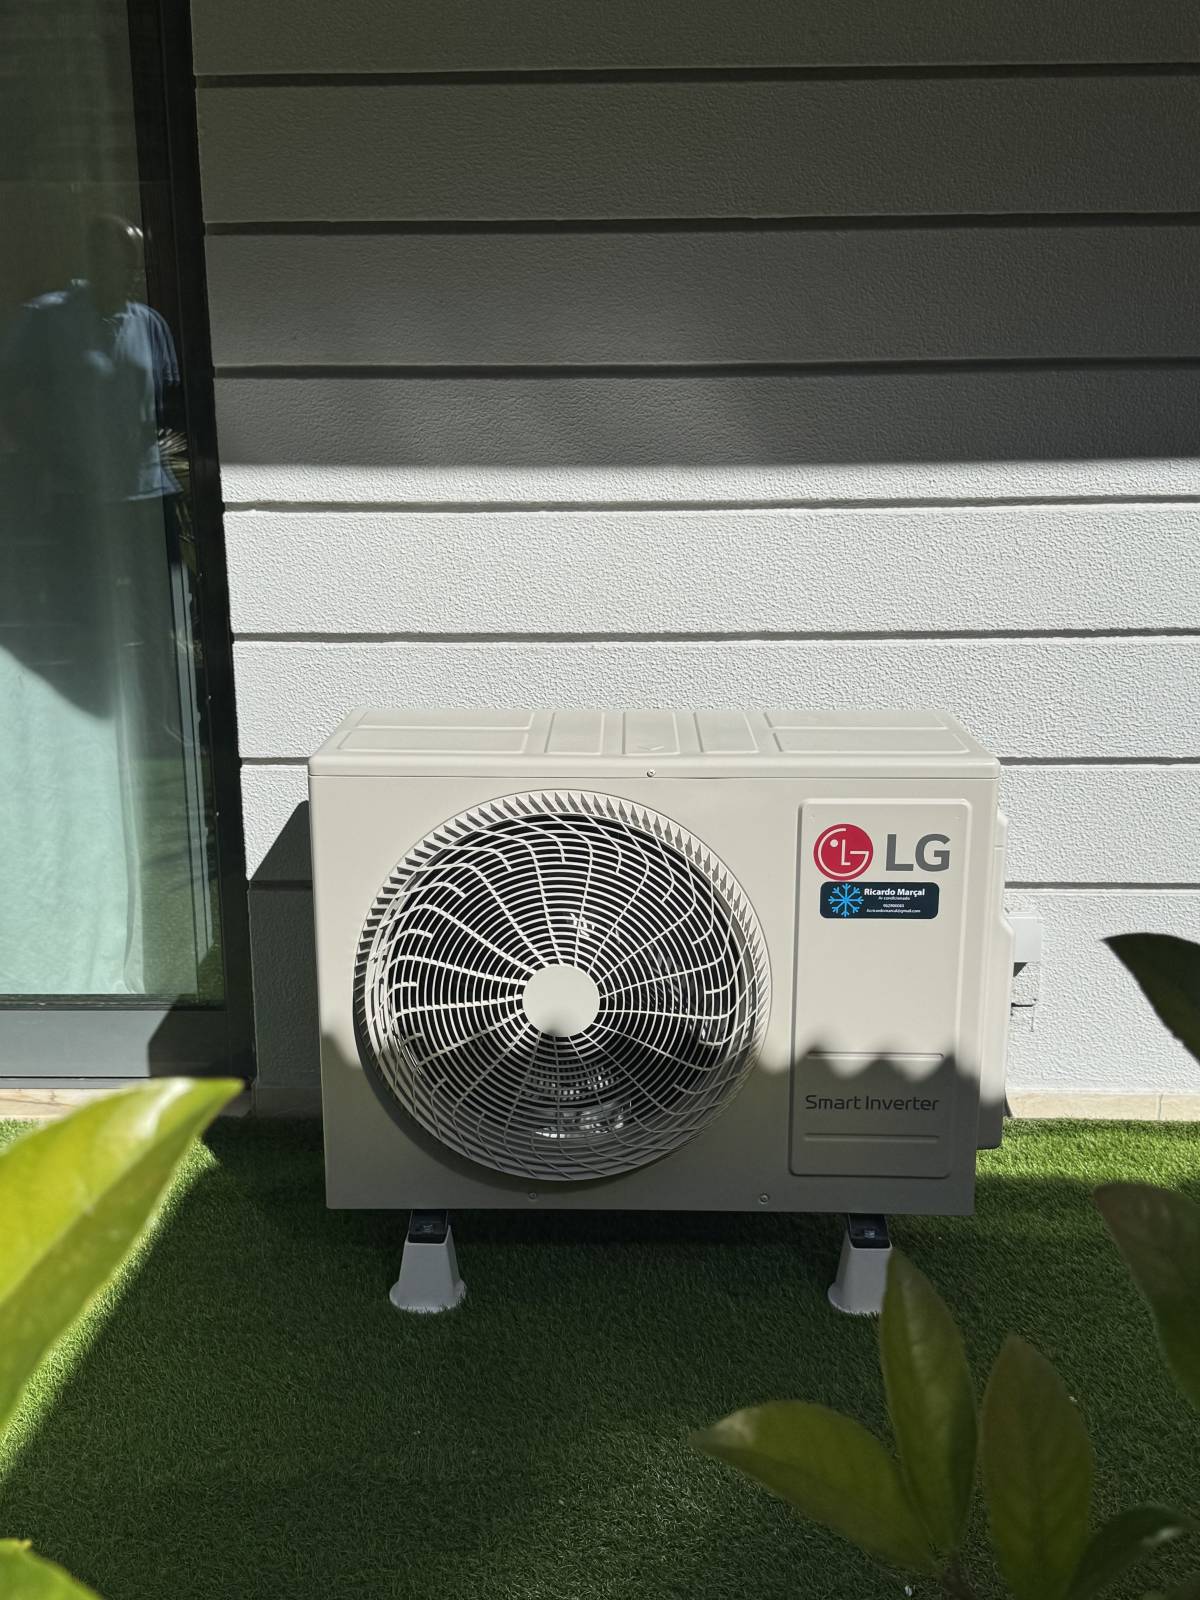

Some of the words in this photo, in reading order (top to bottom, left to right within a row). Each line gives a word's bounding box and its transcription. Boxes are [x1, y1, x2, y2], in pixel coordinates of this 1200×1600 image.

[885, 833, 951, 873] LG
[864, 888, 896, 896] Ricardo
[897, 888, 925, 898] Marçal
[805, 1094, 862, 1110] Smart
[865, 1095, 940, 1111] Inverter
